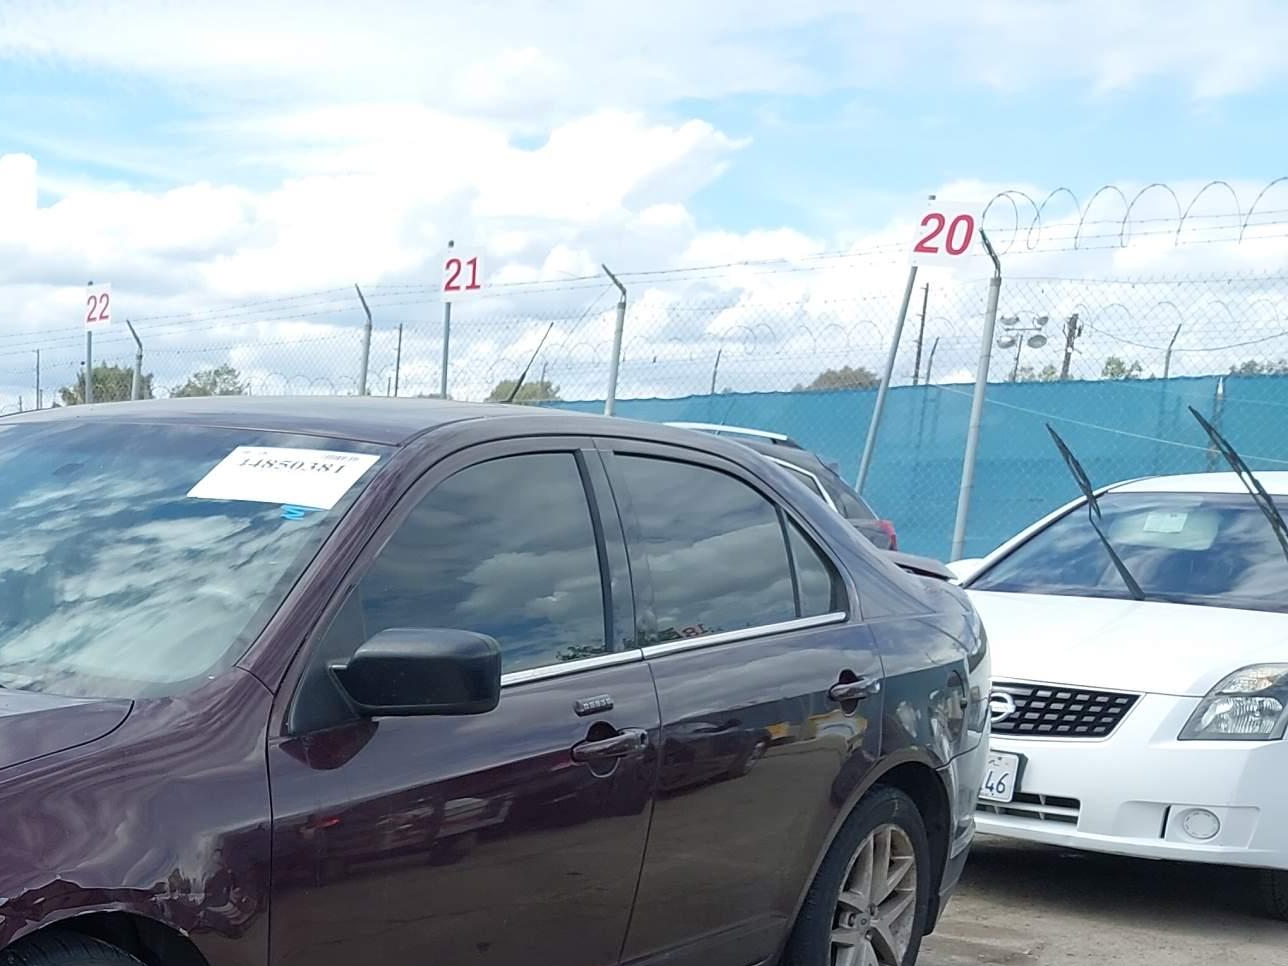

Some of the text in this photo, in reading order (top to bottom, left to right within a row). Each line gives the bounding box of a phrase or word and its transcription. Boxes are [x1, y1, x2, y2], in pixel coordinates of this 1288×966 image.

[913, 212, 974, 255] 20
[444, 256, 481, 291] 21
[87, 293, 109, 322] 22
